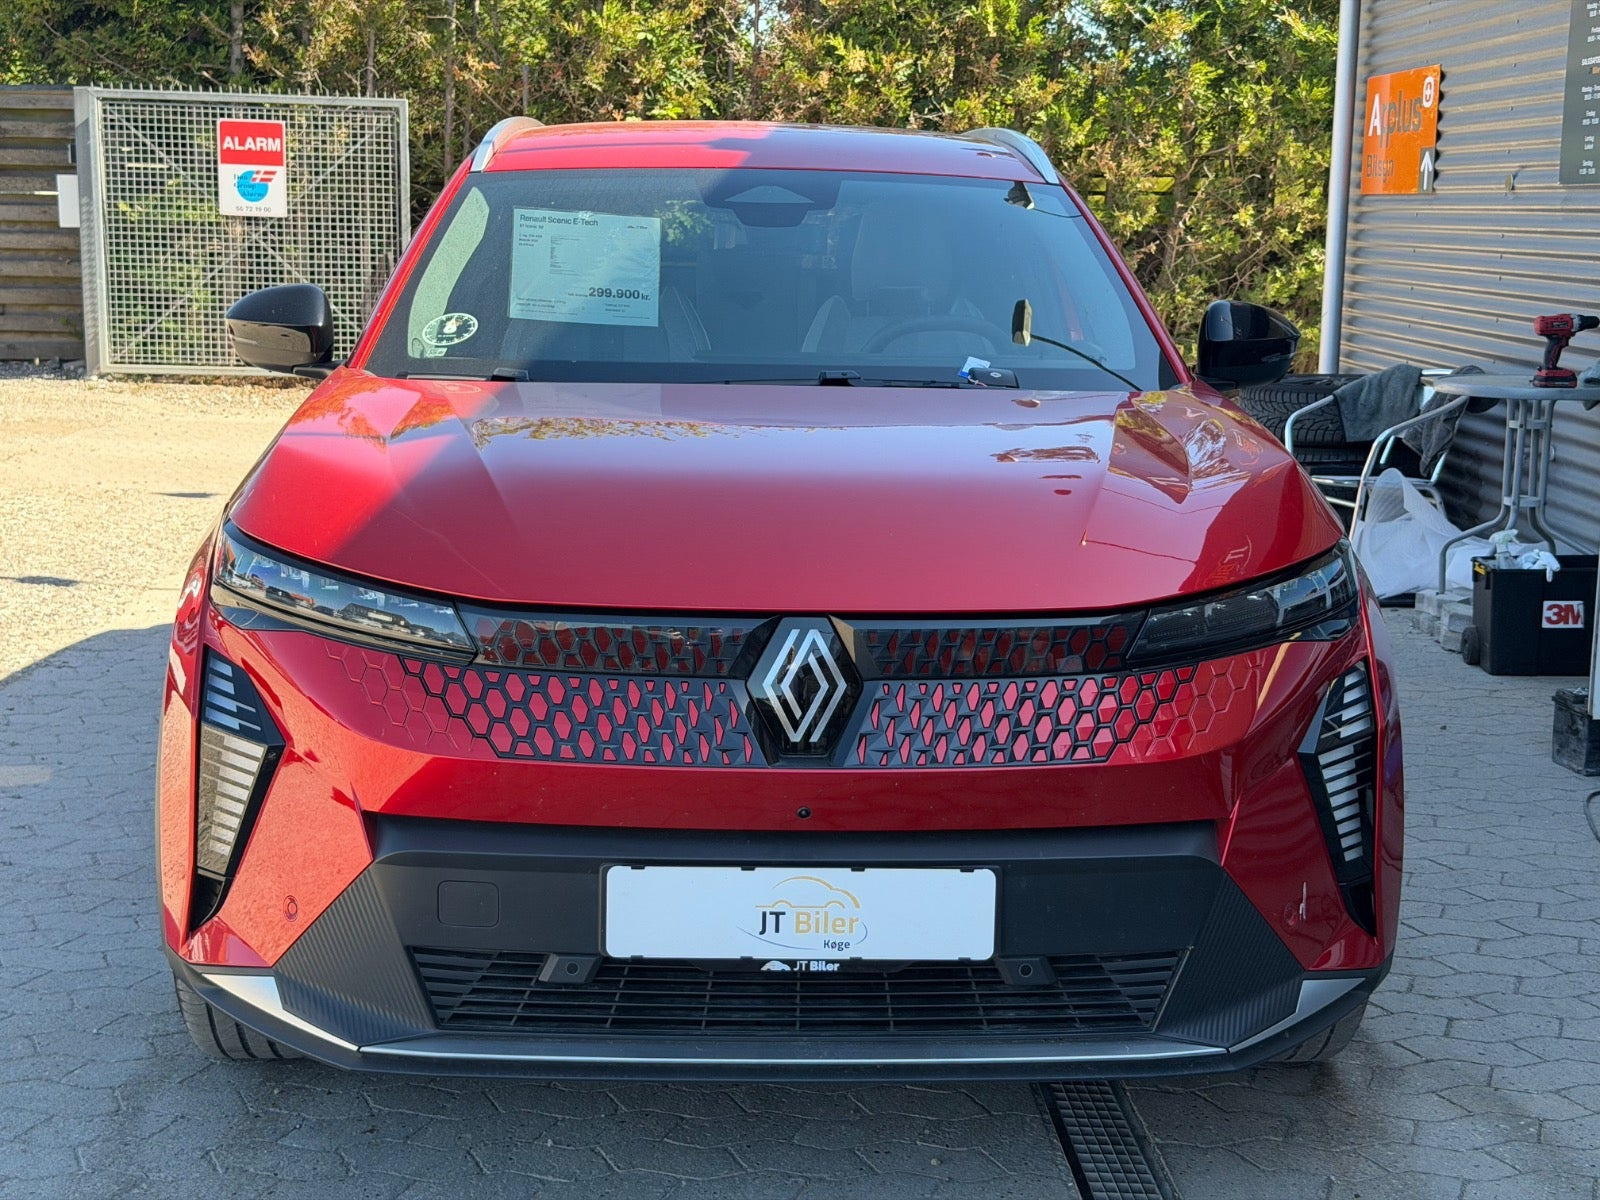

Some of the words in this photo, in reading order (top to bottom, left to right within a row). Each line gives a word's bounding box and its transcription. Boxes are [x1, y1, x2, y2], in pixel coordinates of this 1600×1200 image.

[223, 136, 281, 152] ALARM
[520, 214, 546, 223] Renault
[548, 216, 572, 225] Scenic
[573, 218, 598, 227] E-Tech
[588, 287, 640, 299] 299.900
[1544, 603, 1583, 625] 3M
[758, 911, 786, 936] JT
[795, 911, 859, 934] Biler
[823, 939, 850, 951] Køge
[793, 961, 808, 971] JT
[809, 960, 840, 972] Biler
